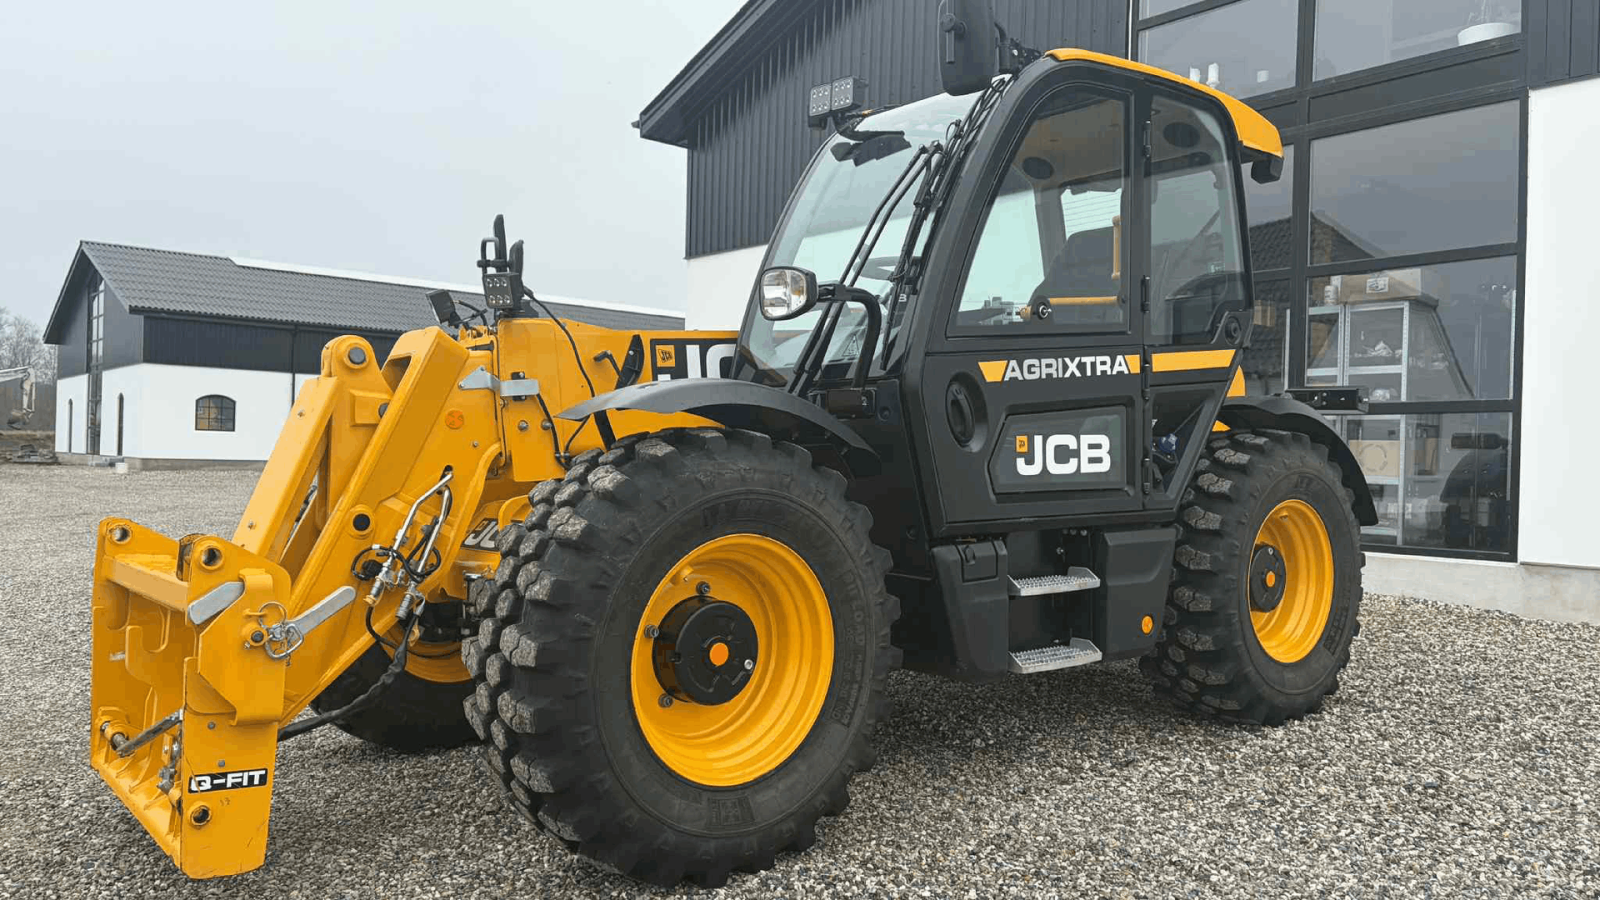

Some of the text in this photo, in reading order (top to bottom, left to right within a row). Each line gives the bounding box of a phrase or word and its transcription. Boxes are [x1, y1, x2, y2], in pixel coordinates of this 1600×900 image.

[1004, 355, 1129, 381] AGRIXTRA
[1016, 434, 1111, 475] JCB
[190, 769, 266, 791] Q-FIT
